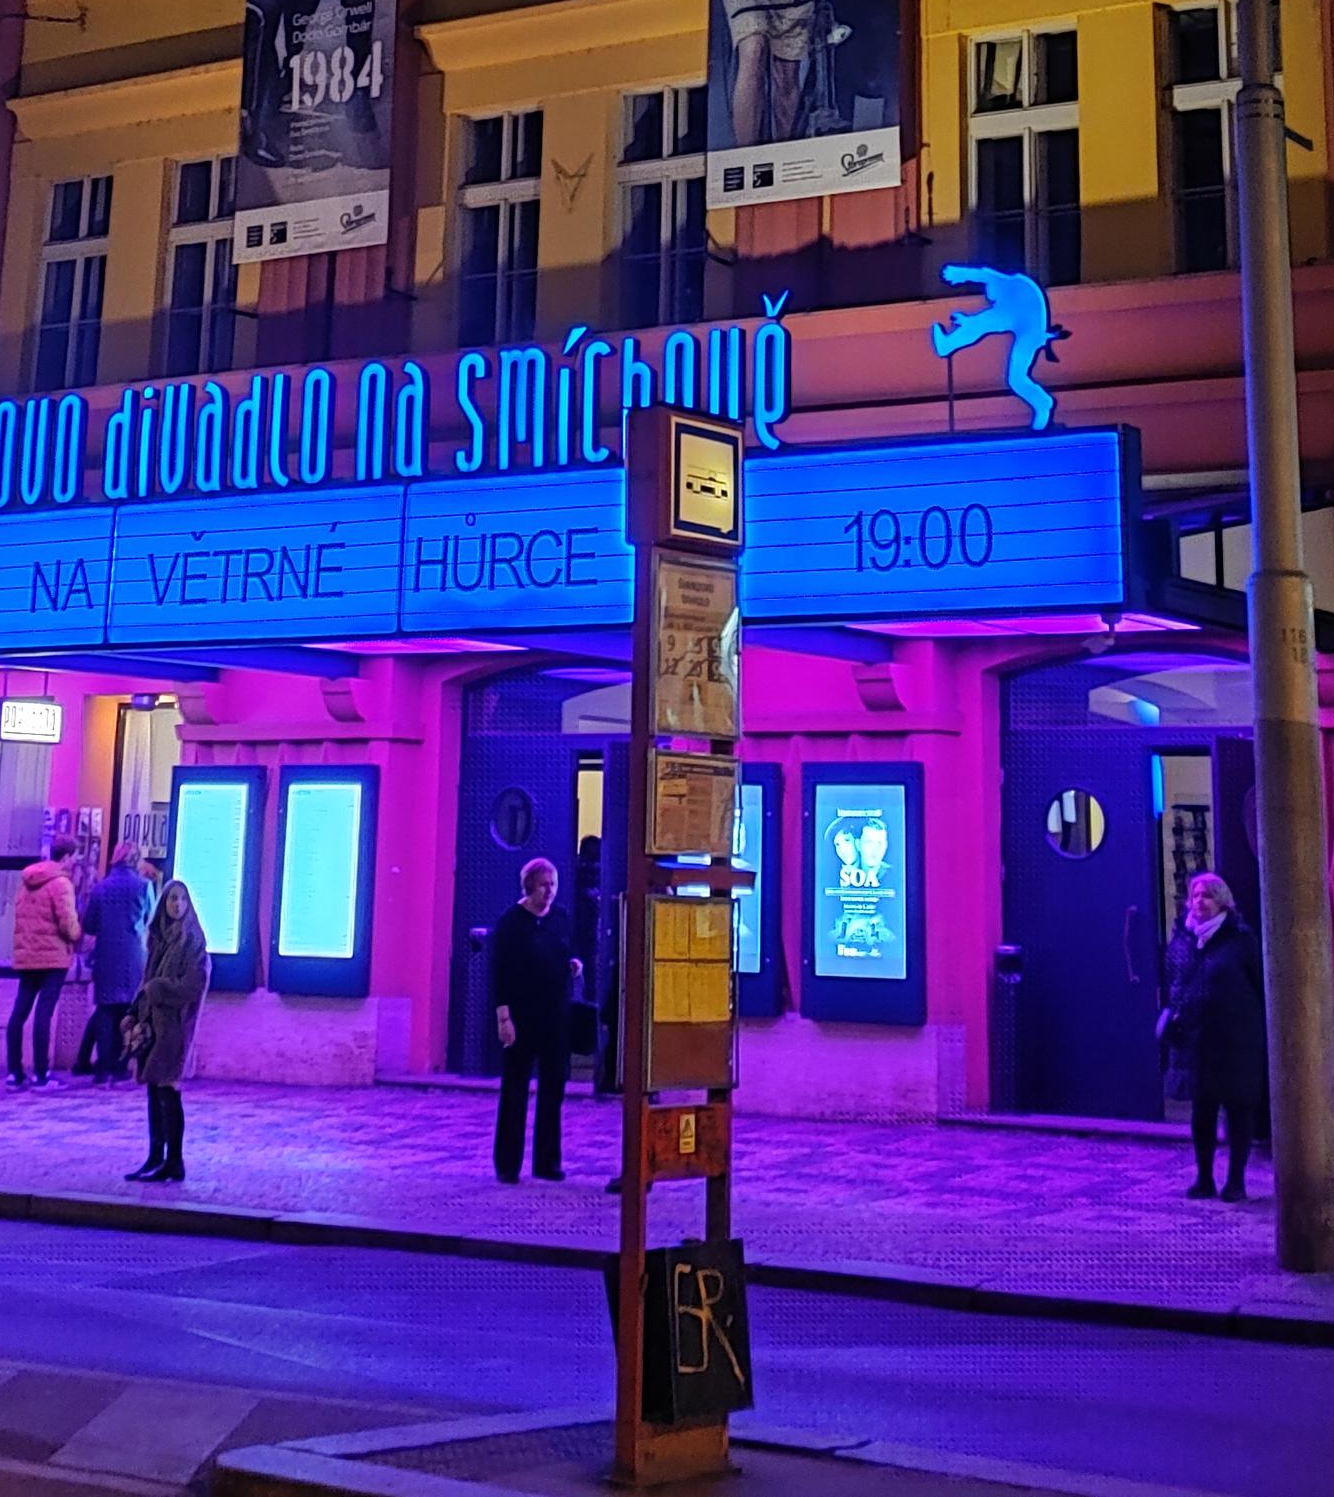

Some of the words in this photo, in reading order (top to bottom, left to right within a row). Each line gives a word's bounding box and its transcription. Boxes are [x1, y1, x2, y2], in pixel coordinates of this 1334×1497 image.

[292, 7, 332, 27] George
[289, 40, 384, 111] 1984
[104, 367, 332, 500] divadlo
[356, 361, 427, 481] na
[29, 557, 95, 614] NA
[147, 521, 347, 606] VĚTRNÉ
[412, 511, 599, 593] HŮRCE
[844, 503, 993, 573] 19:00
